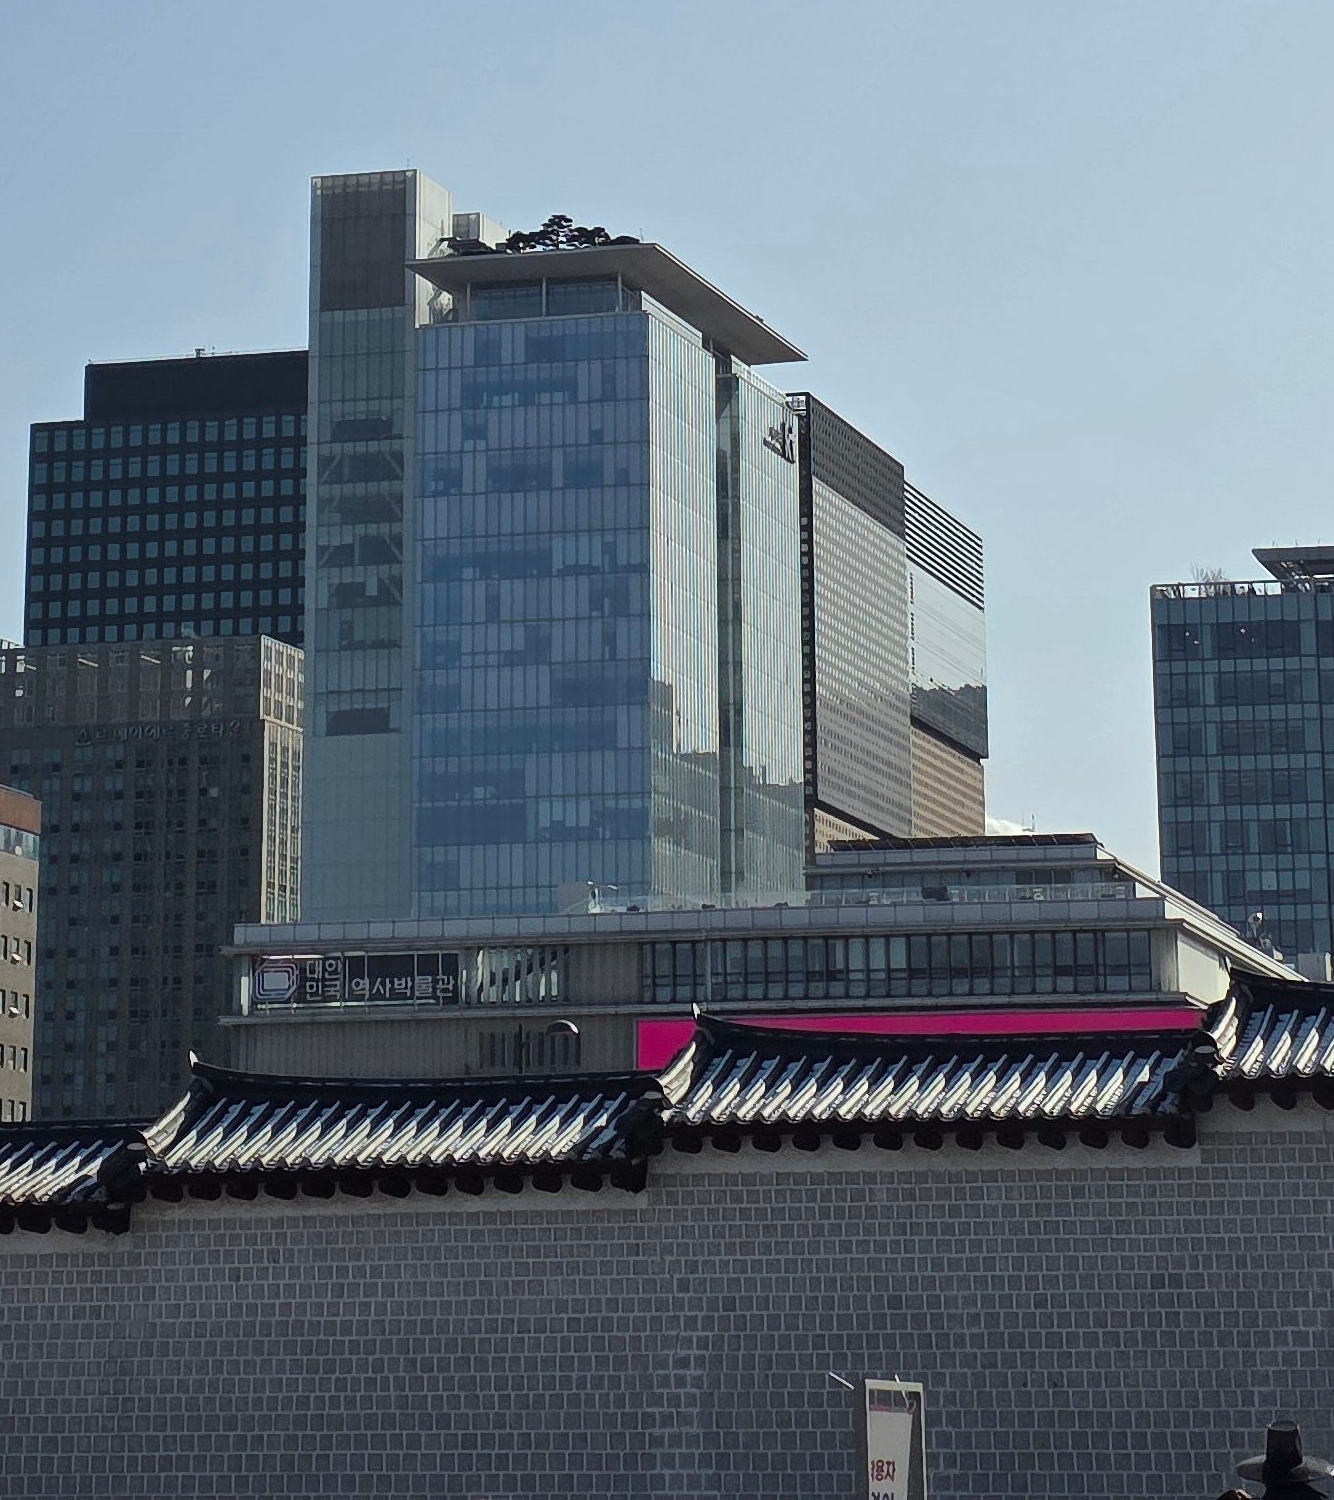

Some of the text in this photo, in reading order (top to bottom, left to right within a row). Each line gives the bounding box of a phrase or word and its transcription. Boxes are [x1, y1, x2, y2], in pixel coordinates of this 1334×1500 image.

[305, 959, 343, 980] 대한
[305, 979, 343, 1000] 민국
[350, 974, 456, 999] 역사박물관
